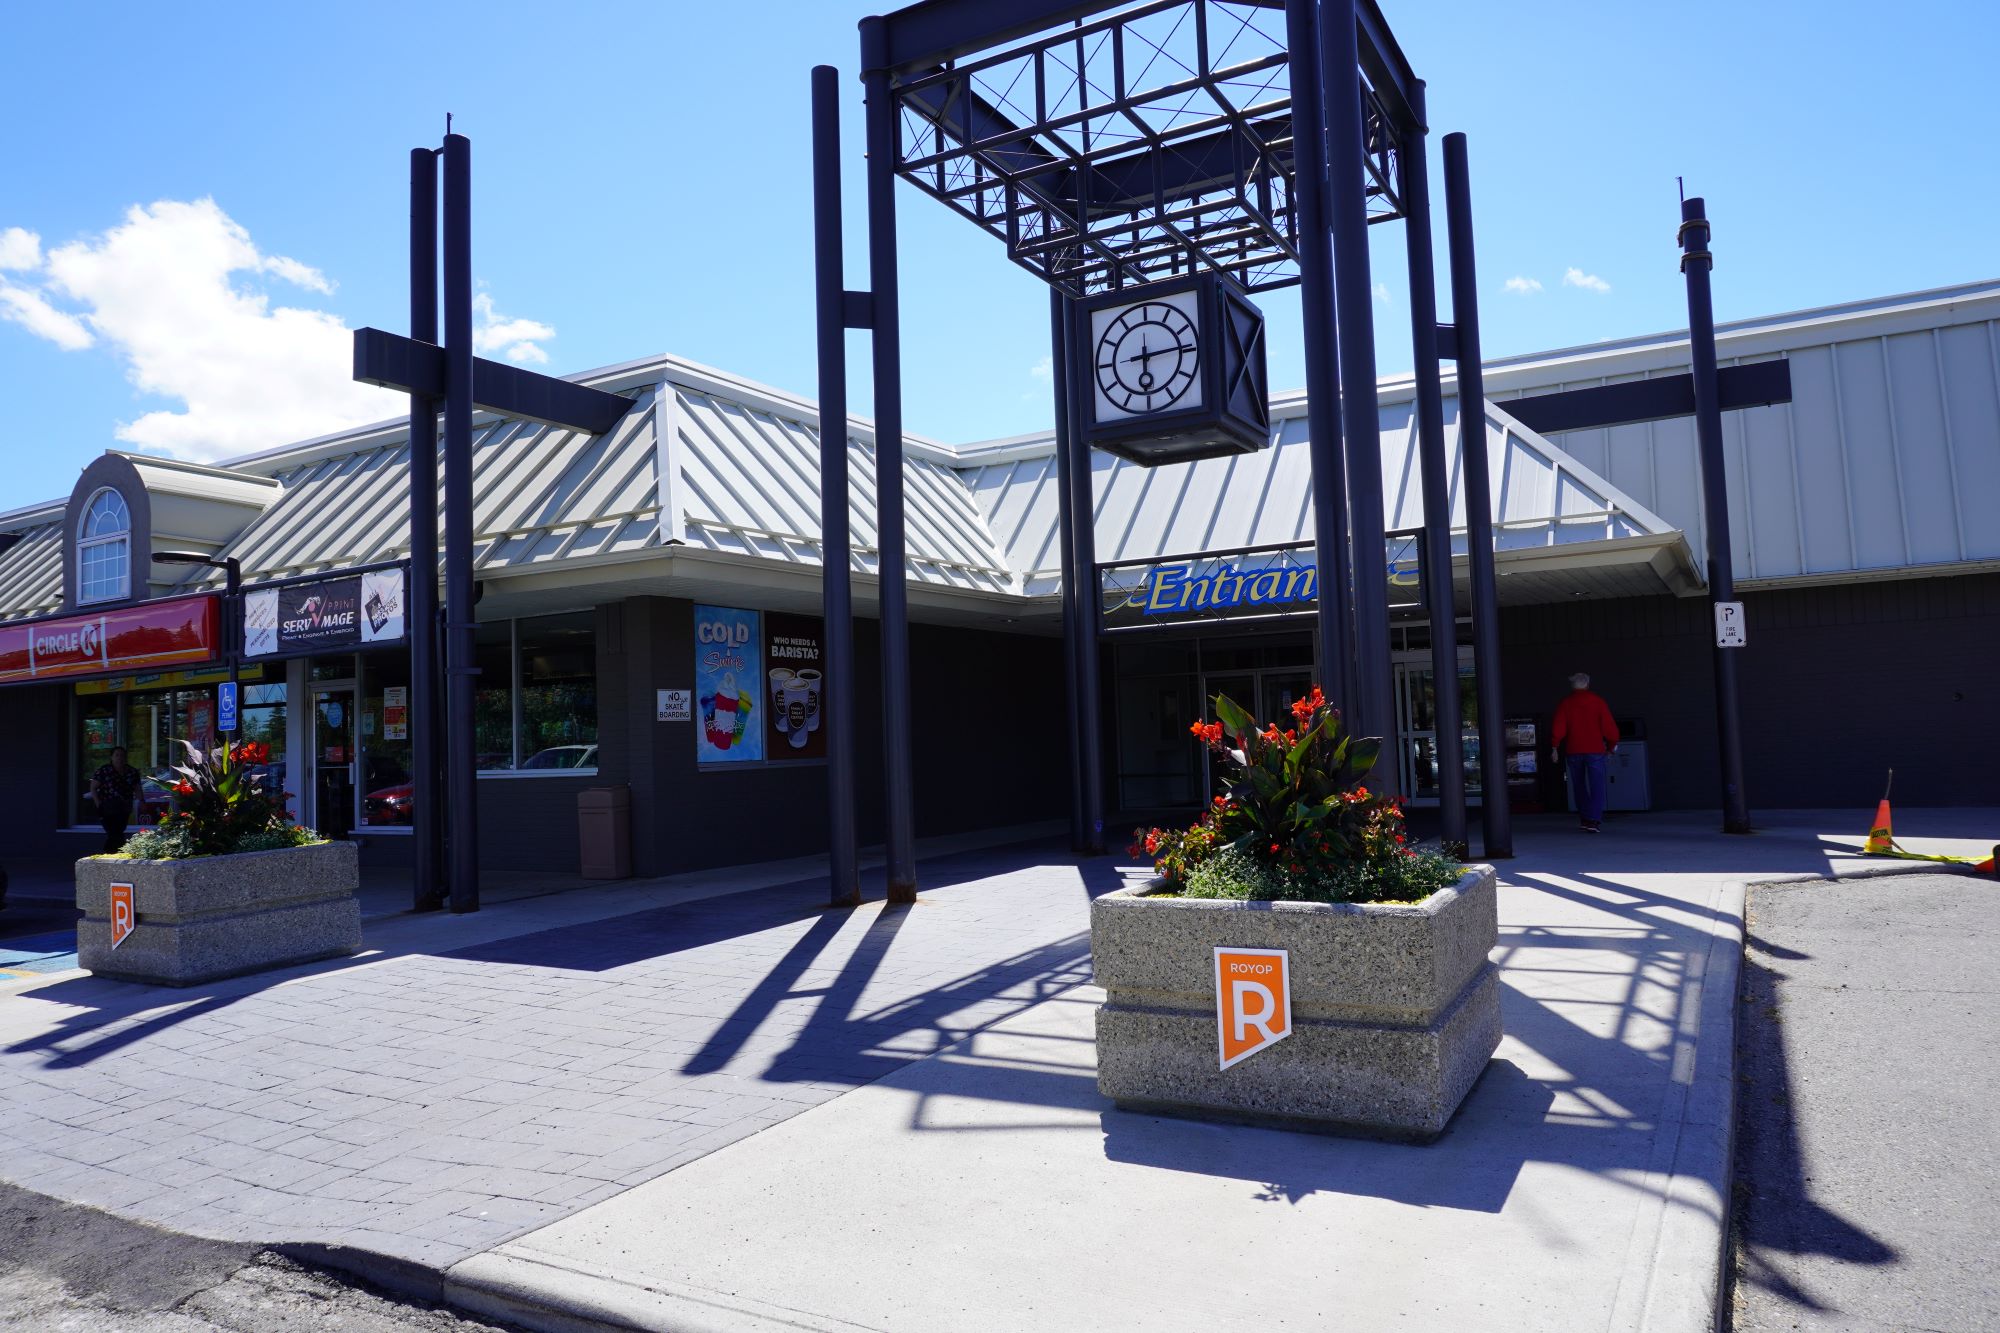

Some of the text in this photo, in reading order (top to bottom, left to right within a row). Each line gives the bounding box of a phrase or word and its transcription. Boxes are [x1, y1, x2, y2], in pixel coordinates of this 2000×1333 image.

[1149, 568, 1316, 610] Entran
[328, 598, 355, 611] PRINT
[373, 602, 398, 628] PHOTOS
[36, 632, 80, 656] CIRCLE
[698, 621, 749, 649] COLD
[773, 635, 817, 647] WHO NEEDS A
[771, 645, 819, 660] BARISTA?
[668, 691, 680, 701] NO
[116, 900, 129, 934] R
[1230, 963, 1273, 975] ROYOP
[1232, 980, 1275, 1041] R
